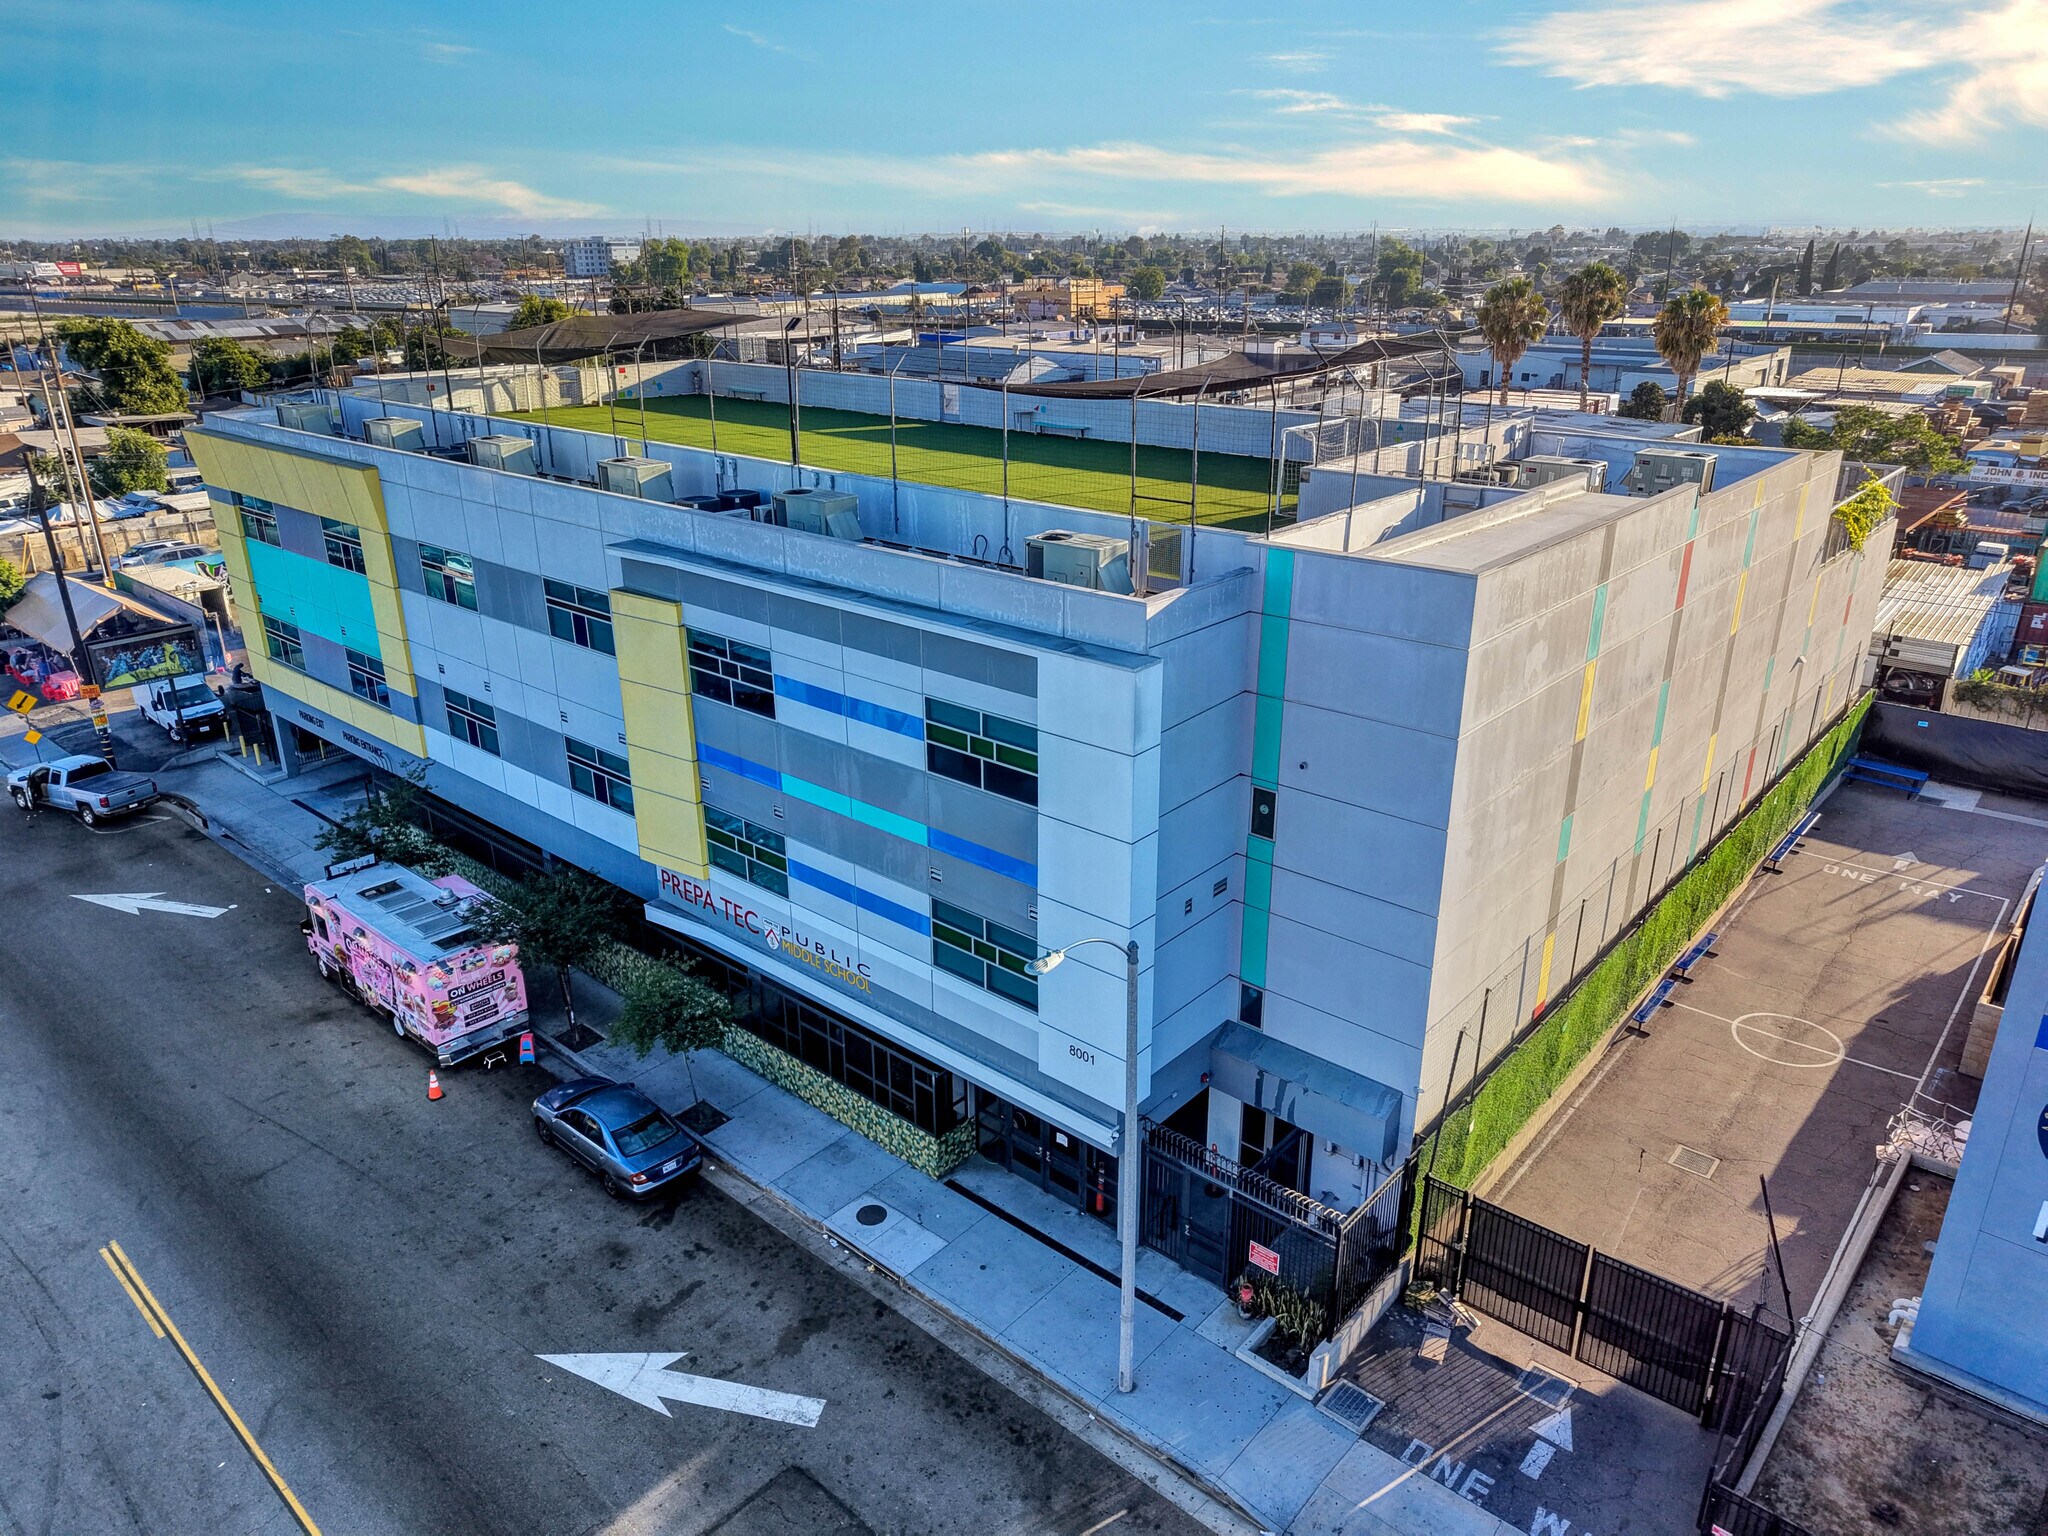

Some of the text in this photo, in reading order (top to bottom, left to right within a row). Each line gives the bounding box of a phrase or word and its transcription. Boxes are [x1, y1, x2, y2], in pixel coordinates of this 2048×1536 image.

[1984, 467, 2012, 477] JOHN
[299, 709, 325, 729] PARKING EXIT
[342, 730, 384, 759] PARKING ENTRANCE
[1823, 864, 1964, 903] ONE WAY
[661, 869, 760, 935] PREPA TEC
[781, 925, 872, 978] PUBLIC
[781, 938, 872, 994] MIDDLE SCHOOL
[450, 985, 466, 998] ON
[467, 972, 503, 992] WHEELS
[1069, 1044, 1095, 1066] 8001
[1400, 1438, 1496, 1507] ONE
